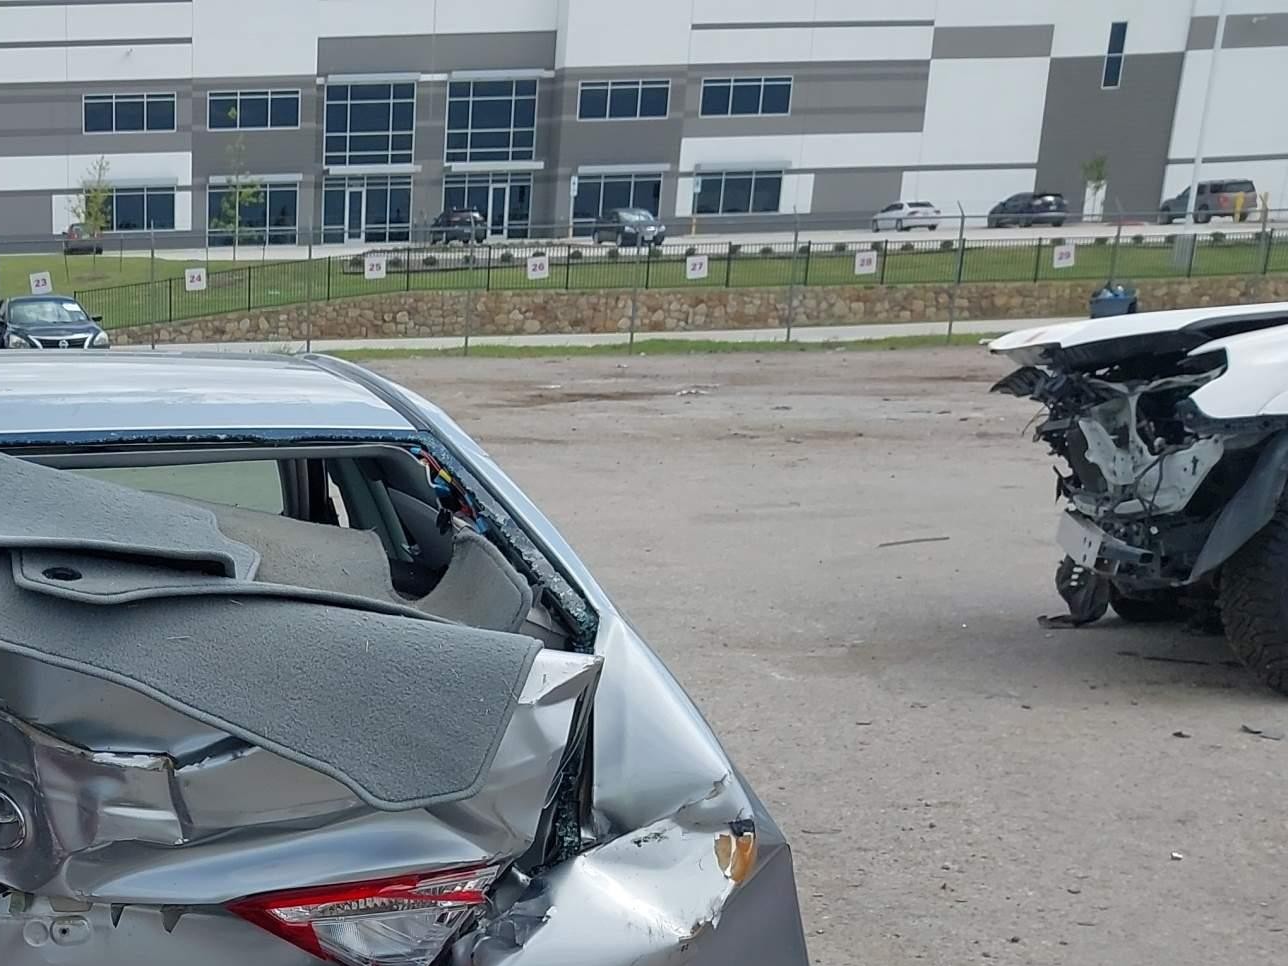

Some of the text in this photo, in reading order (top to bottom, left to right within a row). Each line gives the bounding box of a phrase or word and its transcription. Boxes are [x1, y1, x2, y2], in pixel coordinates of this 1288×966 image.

[368, 263, 381, 272] 25
[531, 263, 544, 272] 26
[690, 262, 703, 271] 27
[34, 278, 48, 288] 23
[189, 274, 202, 283] 24
